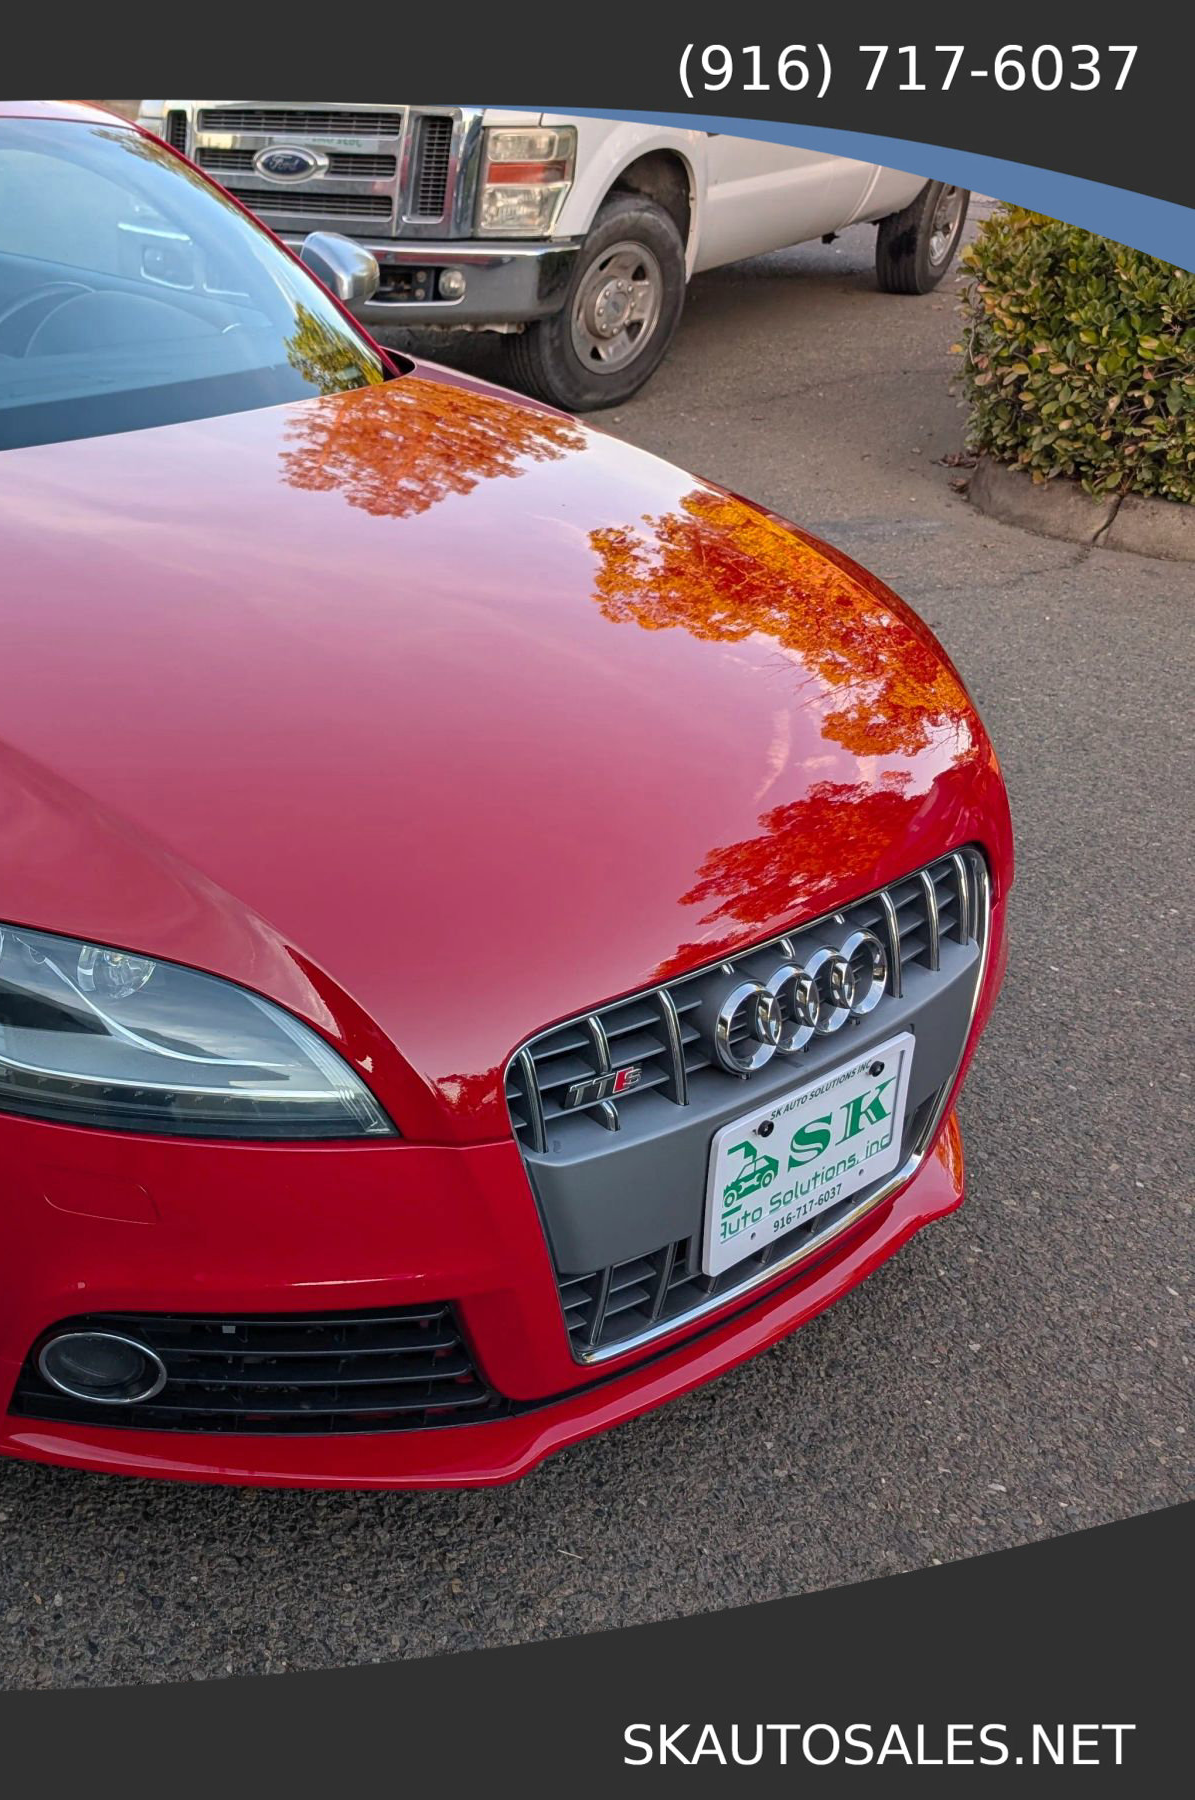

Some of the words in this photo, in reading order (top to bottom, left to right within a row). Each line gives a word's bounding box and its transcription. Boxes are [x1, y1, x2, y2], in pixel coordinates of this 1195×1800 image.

[269, 153, 300, 171] Ford
[770, 1109, 782, 1121] SK
[783, 1096, 808, 1113] AUTO
[809, 1071, 856, 1100] SOLUTIONS
[857, 1060, 872, 1075] INC
[787, 1076, 896, 1172] SK
[769, 1153, 860, 1213] Solutions,
[865, 1133, 892, 1159] inc
[773, 1183, 842, 1233] 916-717-6037
